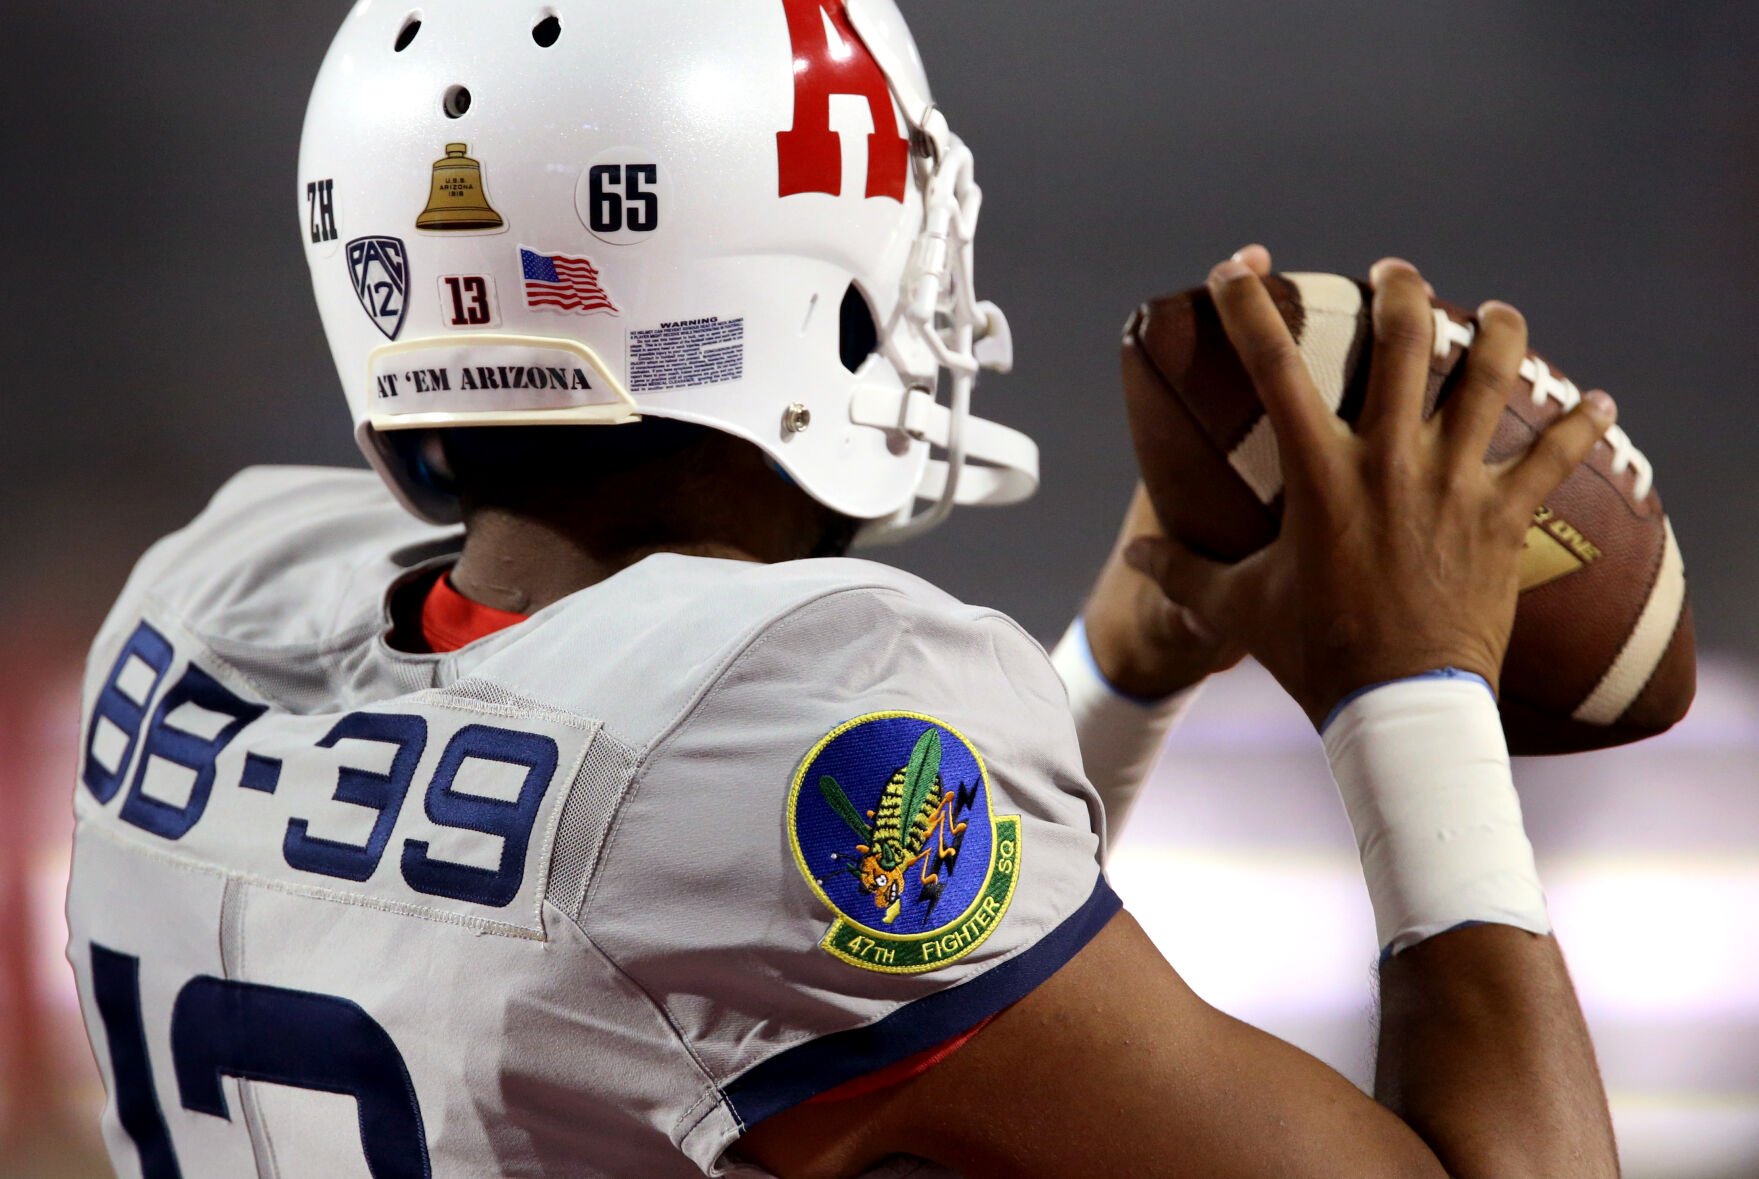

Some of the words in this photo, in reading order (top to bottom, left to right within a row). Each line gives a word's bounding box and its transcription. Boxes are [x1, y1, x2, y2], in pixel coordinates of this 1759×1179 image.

[776, 0, 909, 204] A
[307, 178, 338, 243] ZH
[588, 163, 659, 232] 65
[349, 239, 404, 299] PAC
[367, 281, 399, 318] 12
[444, 276, 491, 325] 13
[660, 316, 718, 329] WARNING
[376, 373, 399, 398] AT
[460, 366, 592, 391] ARIZONA
[847, 934, 896, 963] 47TH
[922, 895, 1000, 961] FIGHTER
[997, 839, 1015, 874] SQ
